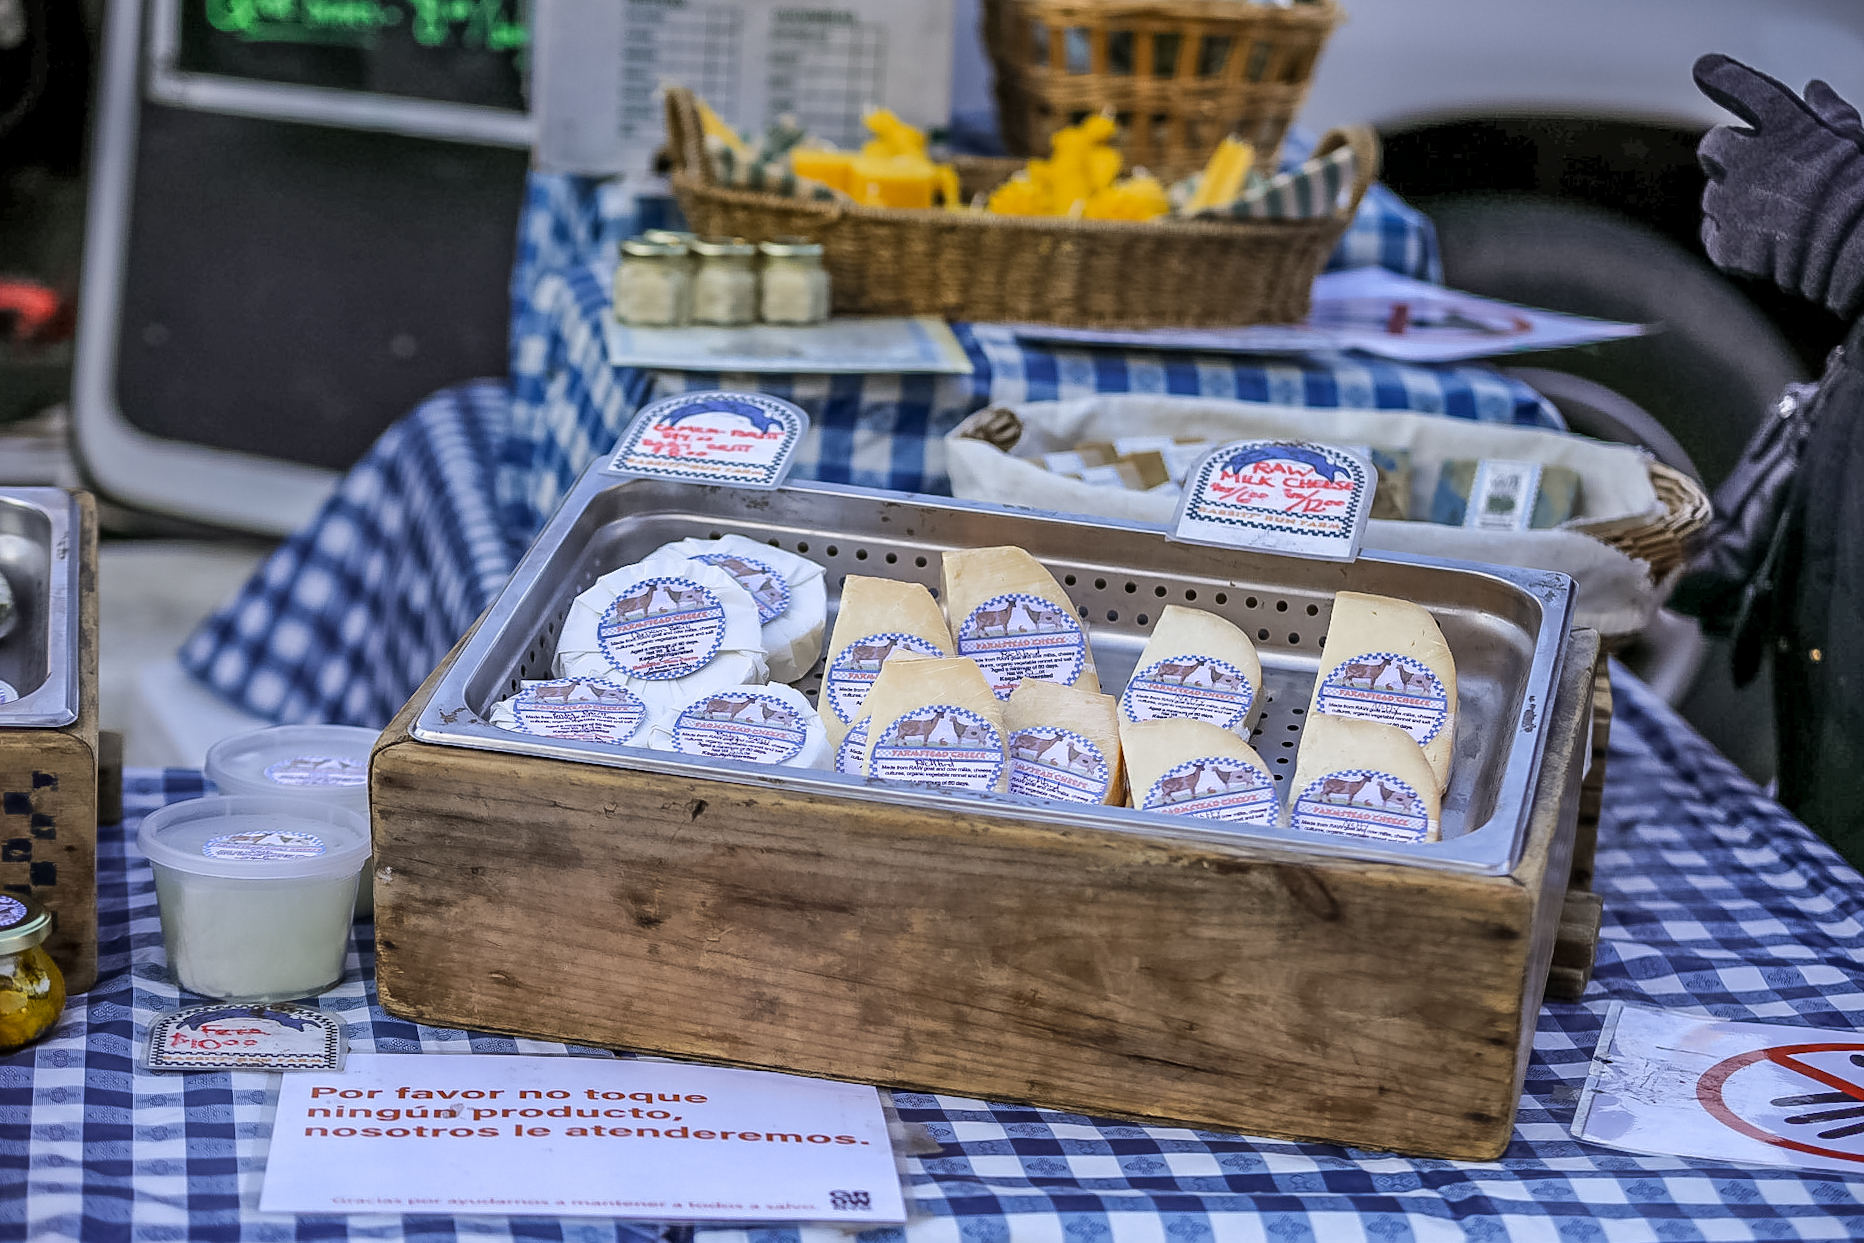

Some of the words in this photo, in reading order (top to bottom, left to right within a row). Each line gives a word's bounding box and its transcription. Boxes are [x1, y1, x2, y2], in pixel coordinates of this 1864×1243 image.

[1253, 461, 1314, 477] RAW
[1220, 470, 1274, 487] MILK
[1283, 477, 1355, 491] CHEESE
[1265, 515, 1296, 525] RUN
[1300, 520, 1341, 529] FARM
[617, 617, 671, 632] FARMSTEAD
[673, 612, 708, 621] CHEESE
[976, 640, 1030, 649] FARMSTEAD
[1032, 637, 1066, 645] CHEESE
[1149, 683, 1201, 696] FARMSTEAD
[1203, 691, 1236, 700] CHEESE
[1339, 690, 1394, 702] FARMSTEAD
[1396, 696, 1430, 706] CHEESE
[694, 722, 750, 733] FARMSTEAD
[752, 729, 787, 738] CHEESE
[892, 750, 948, 758] FARMSTEAD
[1055, 774, 1088, 789] CHEESE
[1221, 795, 1258, 805] CHEESE
[1313, 807, 1370, 820] FARMSTEAD
[1373, 815, 1409, 826] CHEESE
[311, 1087, 384, 1100] Por
[395, 1087, 505, 1100] favor
[519, 1089, 571, 1100] no
[584, 1089, 708, 1104] toque
[308, 1106, 456, 1121] ningún
[472, 1106, 683, 1122] producto,
[305, 1126, 499, 1138] nosotros
[515, 1124, 551, 1138] le
[565, 1125, 870, 1146] atenderemos.
